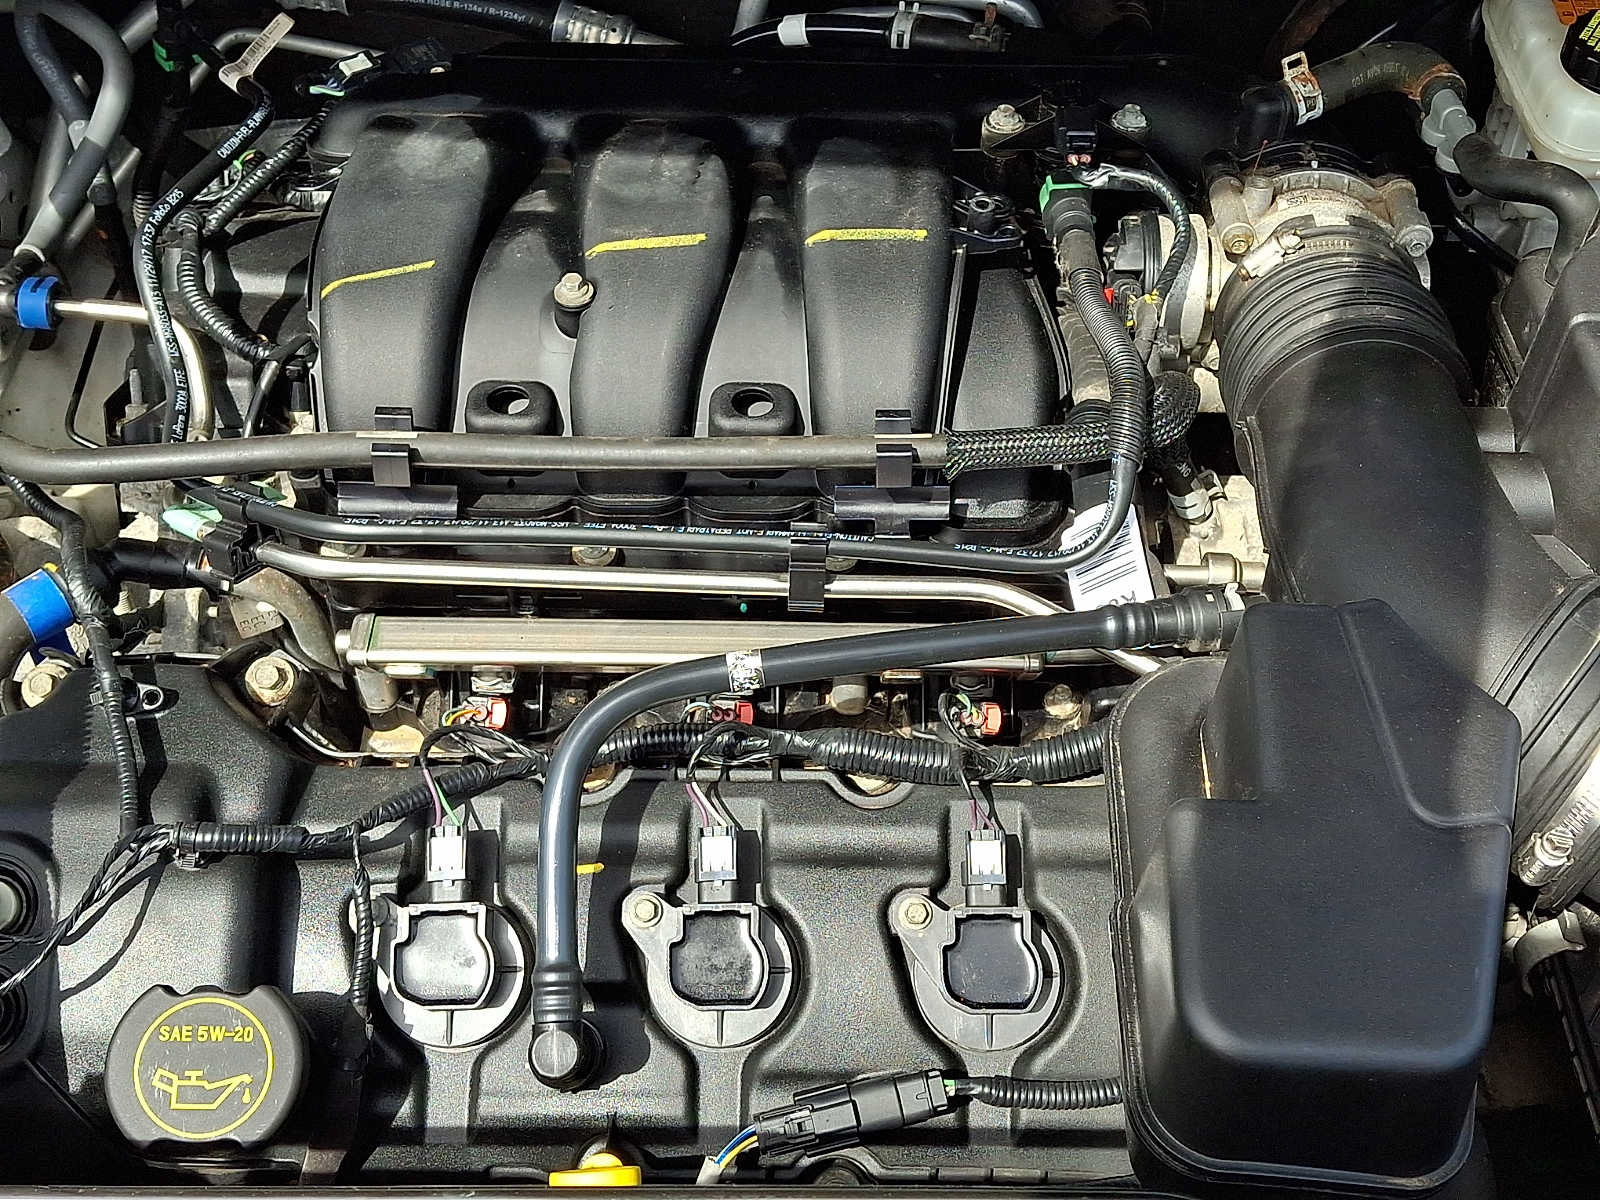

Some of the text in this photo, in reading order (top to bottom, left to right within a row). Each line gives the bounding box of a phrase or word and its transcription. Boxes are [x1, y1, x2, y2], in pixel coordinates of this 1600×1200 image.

[453, 1, 482, 14] R-134a
[165, 187, 185, 206] B215
[148, 202, 171, 226] FoMoCo
[141, 223, 156, 247] 17:37
[158, 1024, 254, 1043] SAE 5W-20
